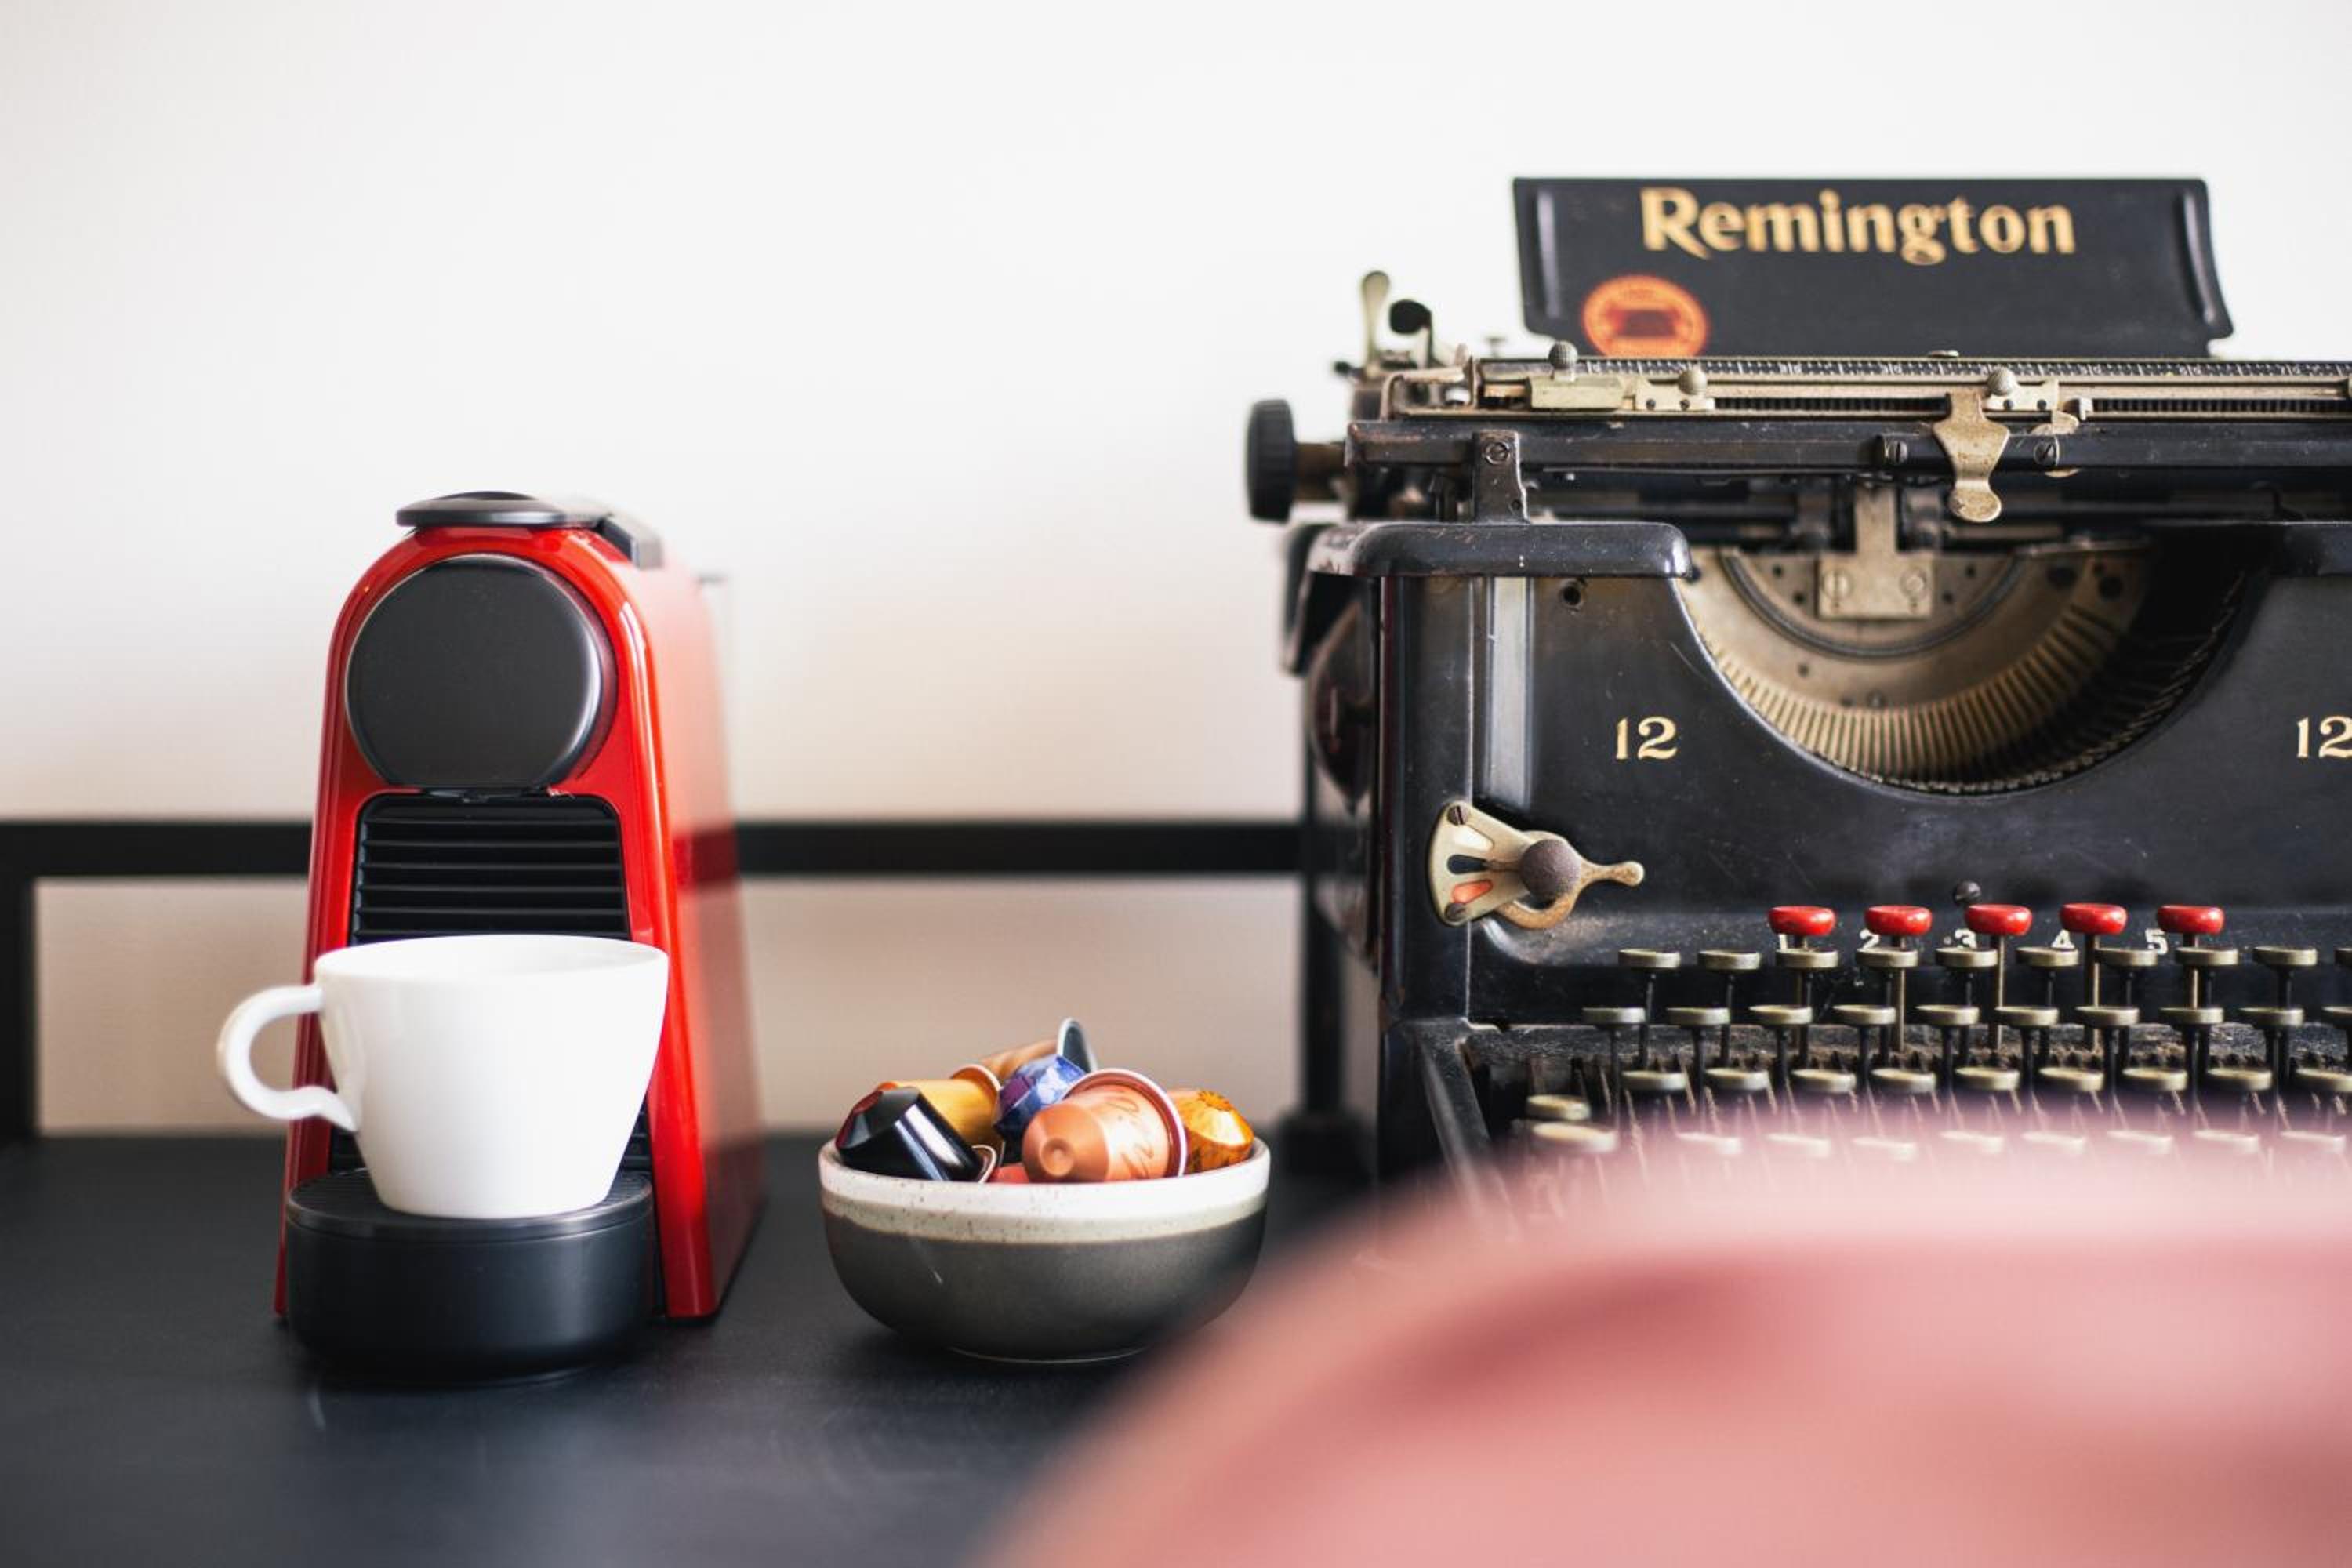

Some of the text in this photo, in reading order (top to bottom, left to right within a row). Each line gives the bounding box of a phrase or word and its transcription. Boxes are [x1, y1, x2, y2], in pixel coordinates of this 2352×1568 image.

[1640, 186, 2076, 266] Remington
[1616, 716, 1678, 760] 12
[2296, 715, 2352, 759] 12
[1859, 928, 1880, 950] 2
[2051, 928, 2076, 949] 4
[2144, 927, 2169, 956] 5
